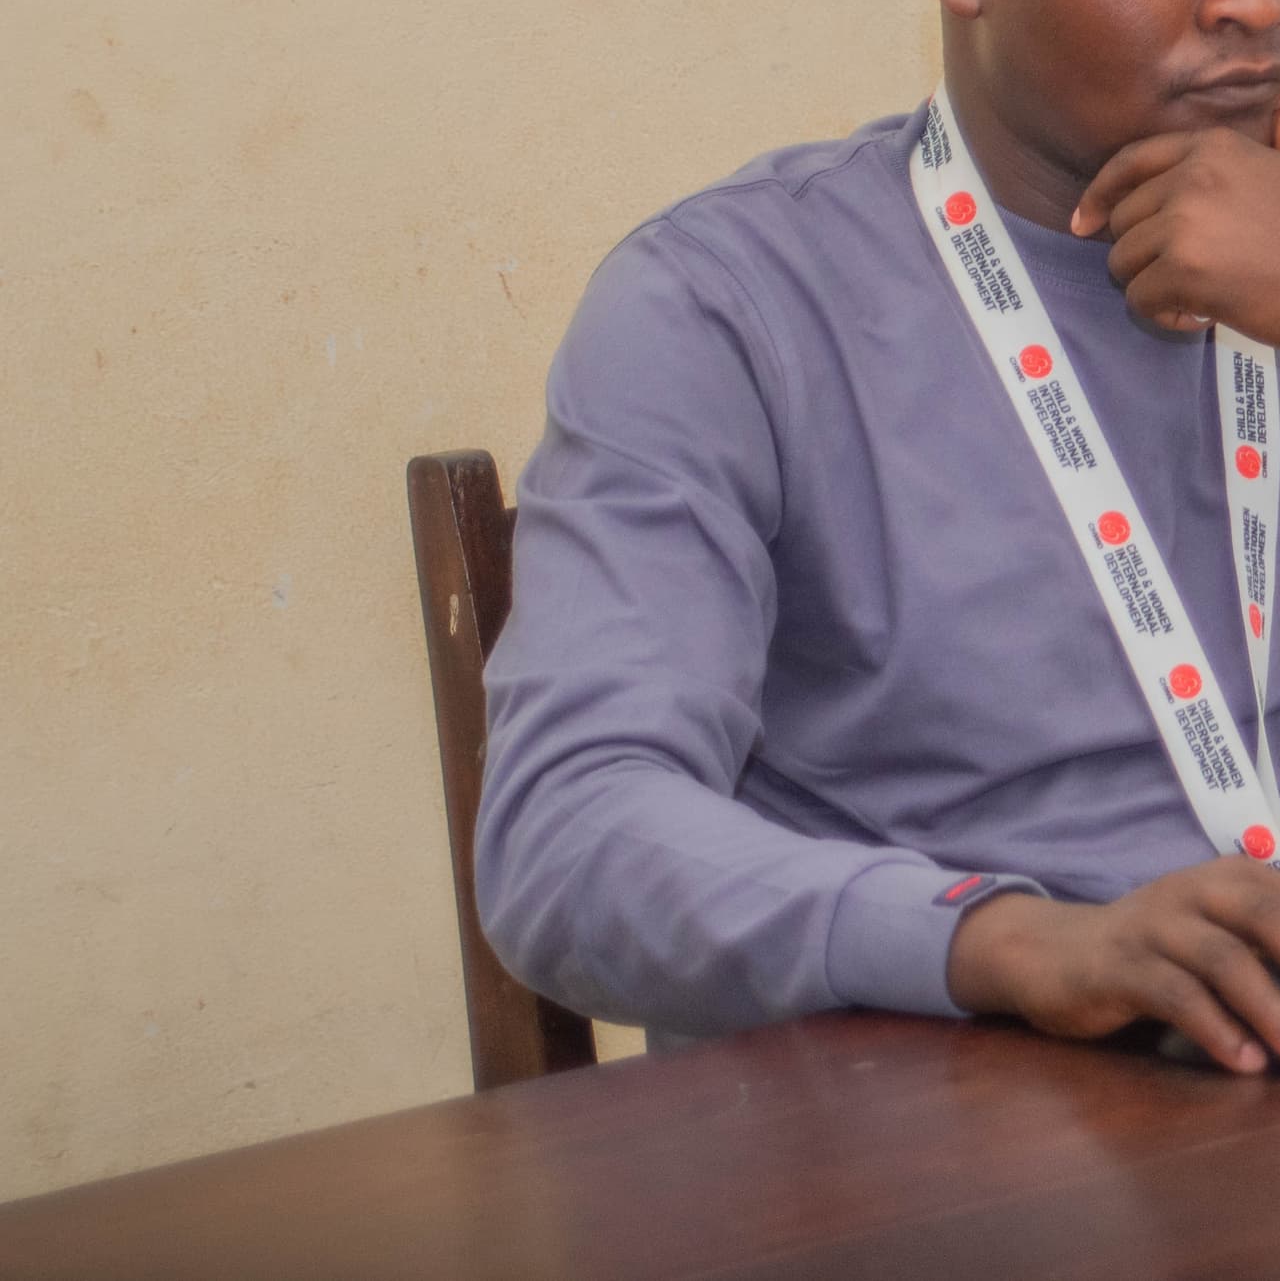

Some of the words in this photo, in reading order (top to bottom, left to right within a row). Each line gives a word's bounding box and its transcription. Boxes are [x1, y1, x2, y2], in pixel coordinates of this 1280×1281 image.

[951, 234, 997, 310] DEVELOPMENT
[961, 229, 1010, 314] INTERNATIONAL
[972, 223, 996, 257] CHILD
[990, 258, 1001, 267] &
[996, 267, 1023, 310] WOMEN
[1233, 351, 1243, 393] WOMEN
[1235, 396, 1244, 405] &
[1244, 356, 1256, 443] INTERNATIONAL
[1255, 363, 1266, 444] DEVELOPMENT
[1027, 389, 1072, 468] DEVELOPMENT
[1038, 384, 1085, 472] INTERNATIONAL
[1049, 380, 1071, 414] CHILD
[1065, 415, 1077, 425] &
[1071, 426, 1097, 468] WOMEN
[1236, 408, 1246, 440] CHILD
[1242, 506, 1250, 551] WOMEN
[1250, 514, 1258, 603] INTERNATIONAL
[1257, 522, 1266, 606] DEVELOPMENT
[1104, 553, 1148, 634] DEVELOPMENT
[1115, 548, 1161, 637] INTERNATIONAL
[1126, 543, 1147, 577] CHILD
[1142, 580, 1153, 589] &
[1148, 590, 1174, 634] WOMEN
[1175, 709, 1219, 790] DEVELOPMENT
[1186, 704, 1232, 793] INTERNATIONAL
[1198, 698, 1220, 734] CHILD
[1214, 735, 1225, 745] &
[1219, 746, 1245, 789] WOMEN
